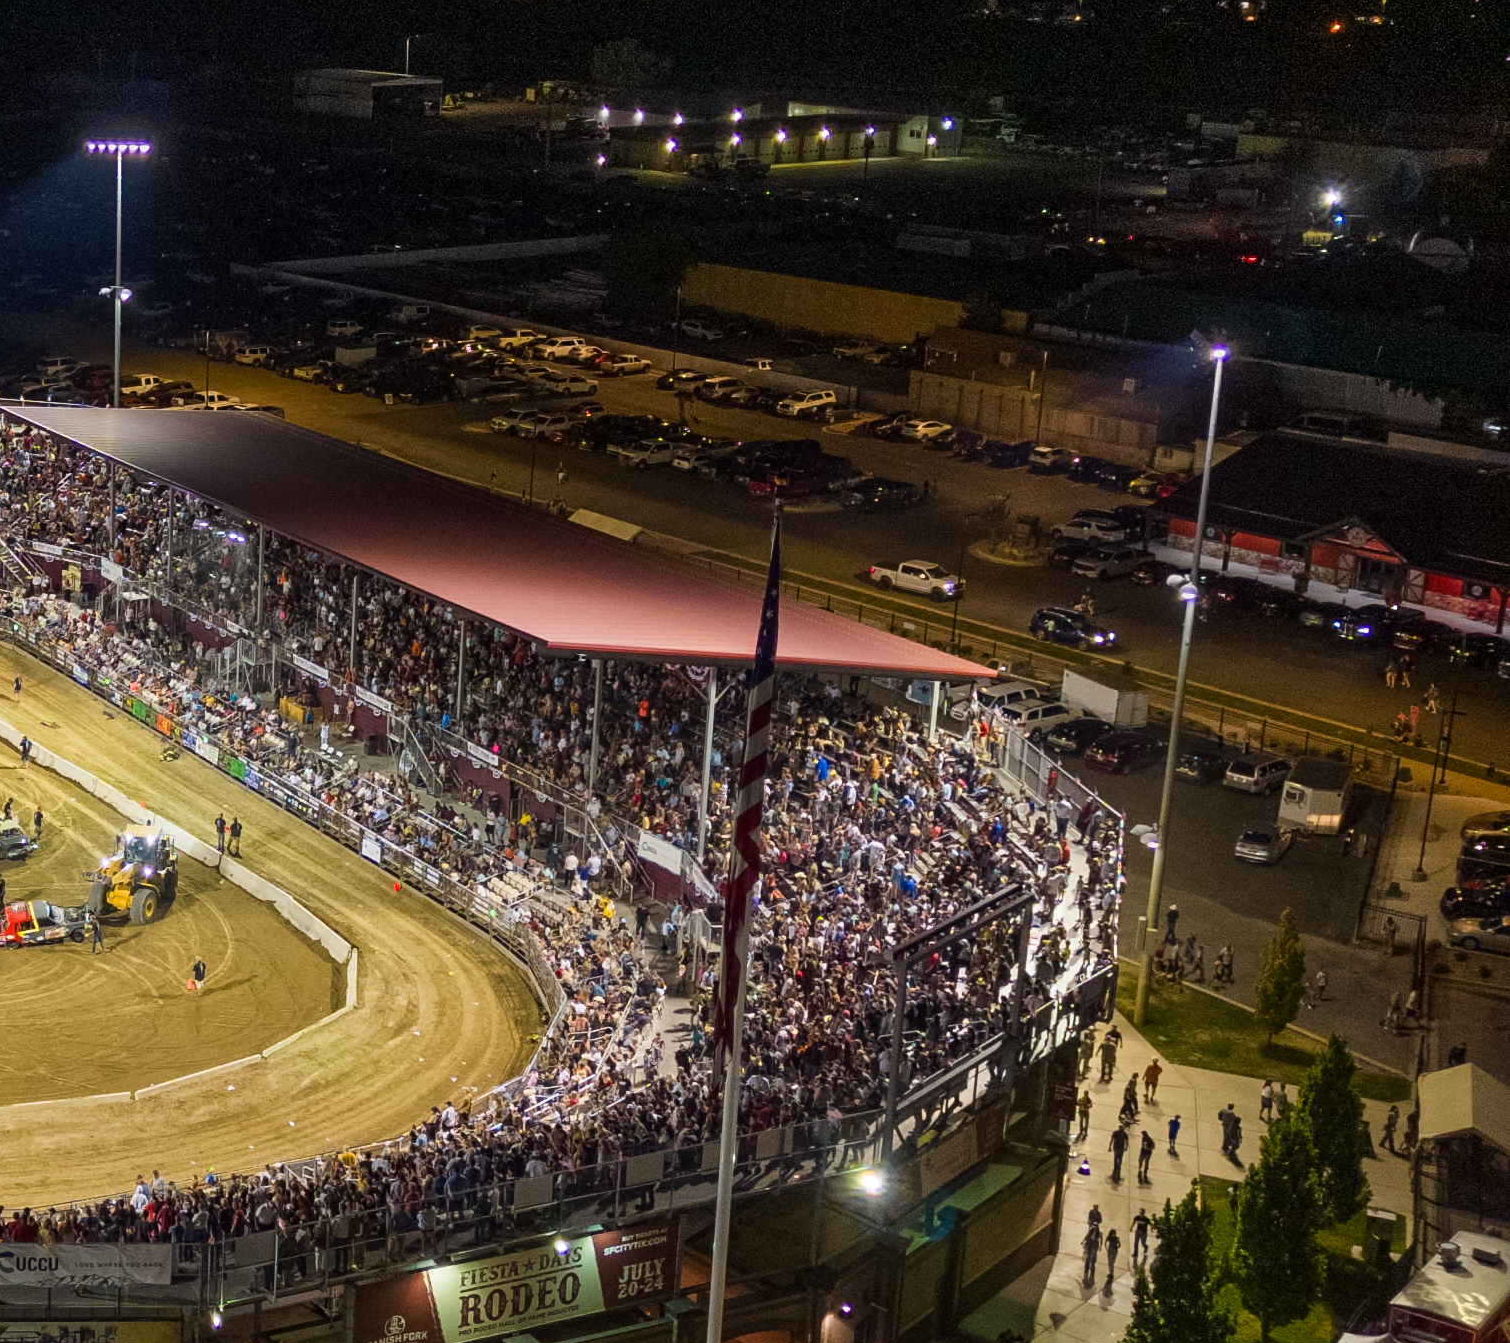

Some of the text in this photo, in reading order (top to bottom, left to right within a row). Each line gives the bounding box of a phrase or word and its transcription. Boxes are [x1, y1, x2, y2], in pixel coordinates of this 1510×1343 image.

[16, 1257, 59, 1272] UCCU
[460, 1246, 583, 1287] FIESTA DAYS
[619, 1258, 666, 1283] JULY
[618, 1274, 663, 1299] 20-24
[458, 1272, 581, 1329] RODEO
[403, 1331, 429, 1341] FORK
[473, 1323, 497, 1333] RODEO
